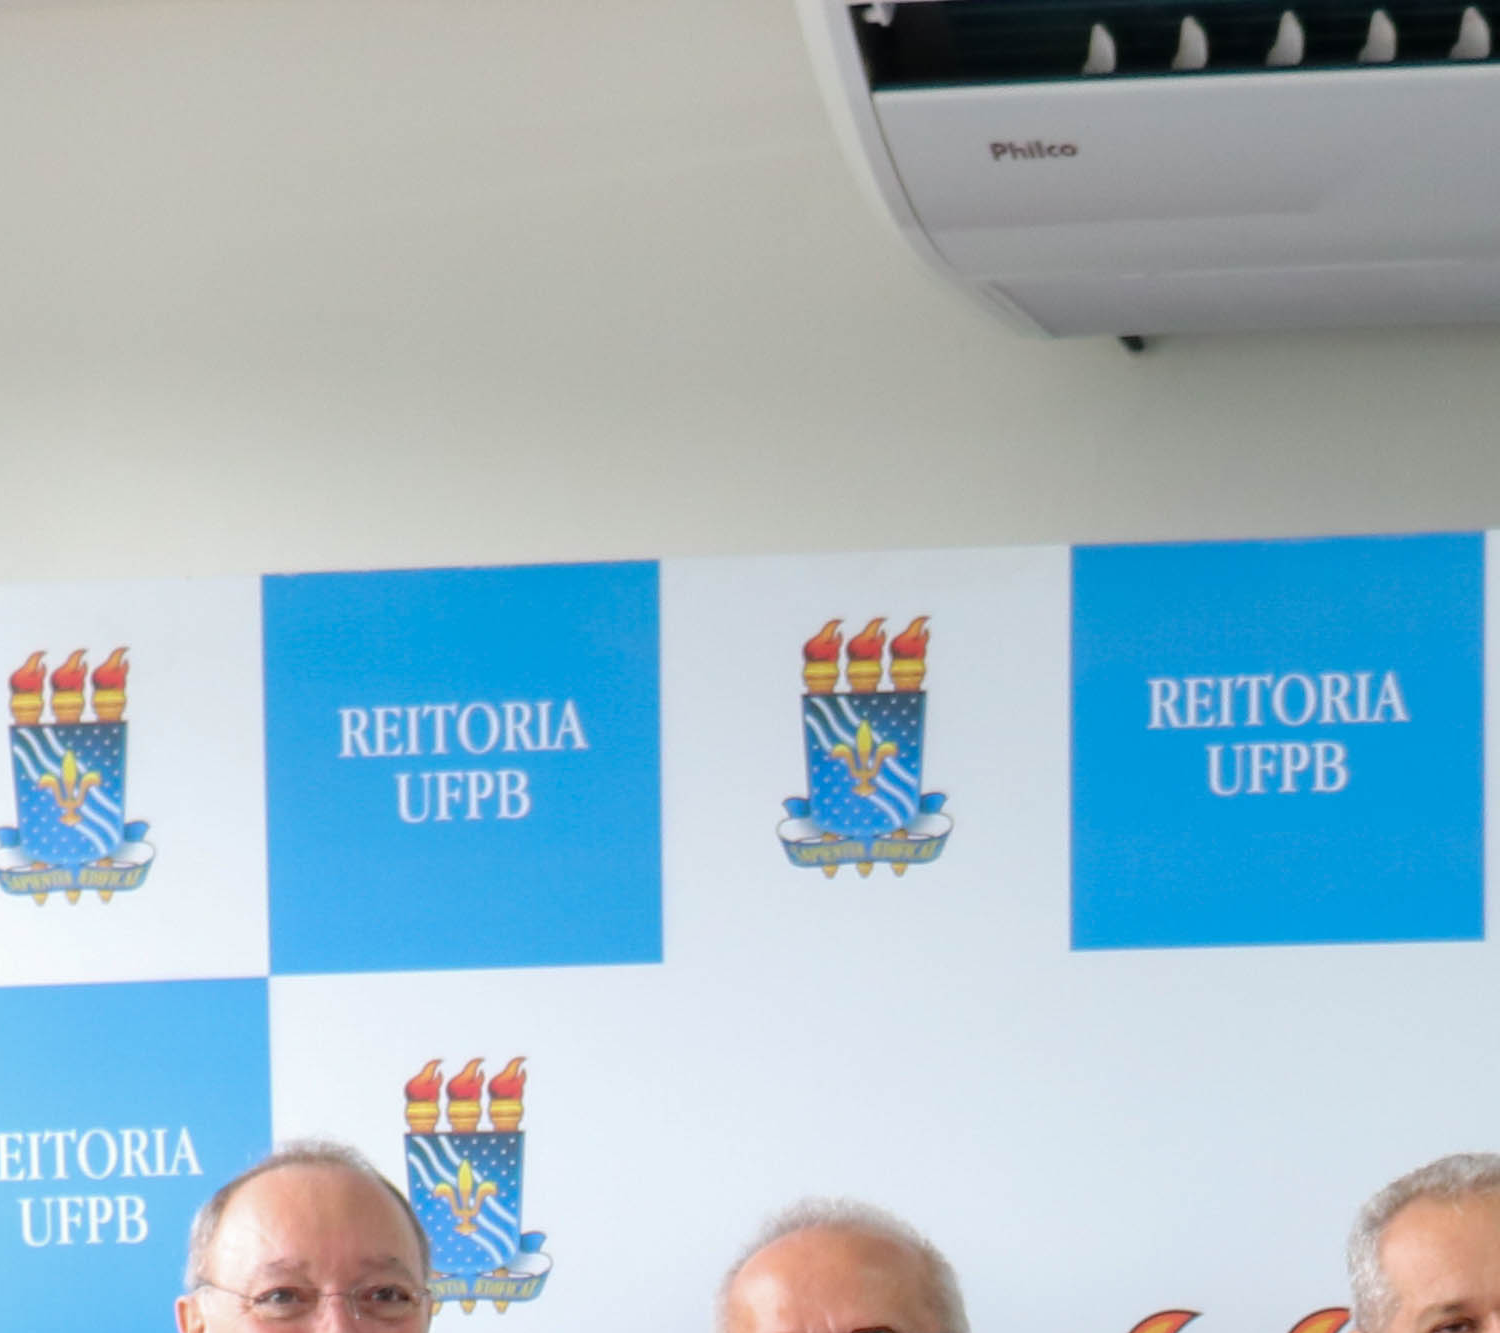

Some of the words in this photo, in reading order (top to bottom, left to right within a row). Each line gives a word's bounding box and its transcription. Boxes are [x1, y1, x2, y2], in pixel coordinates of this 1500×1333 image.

[990, 141, 1078, 160] Philco
[1147, 671, 1410, 730] REITORIA
[338, 700, 589, 758] REITORIA
[395, 769, 532, 824] UFPB
[1206, 740, 1350, 797] UFPB
[19, 1195, 149, 1248] UFPB
